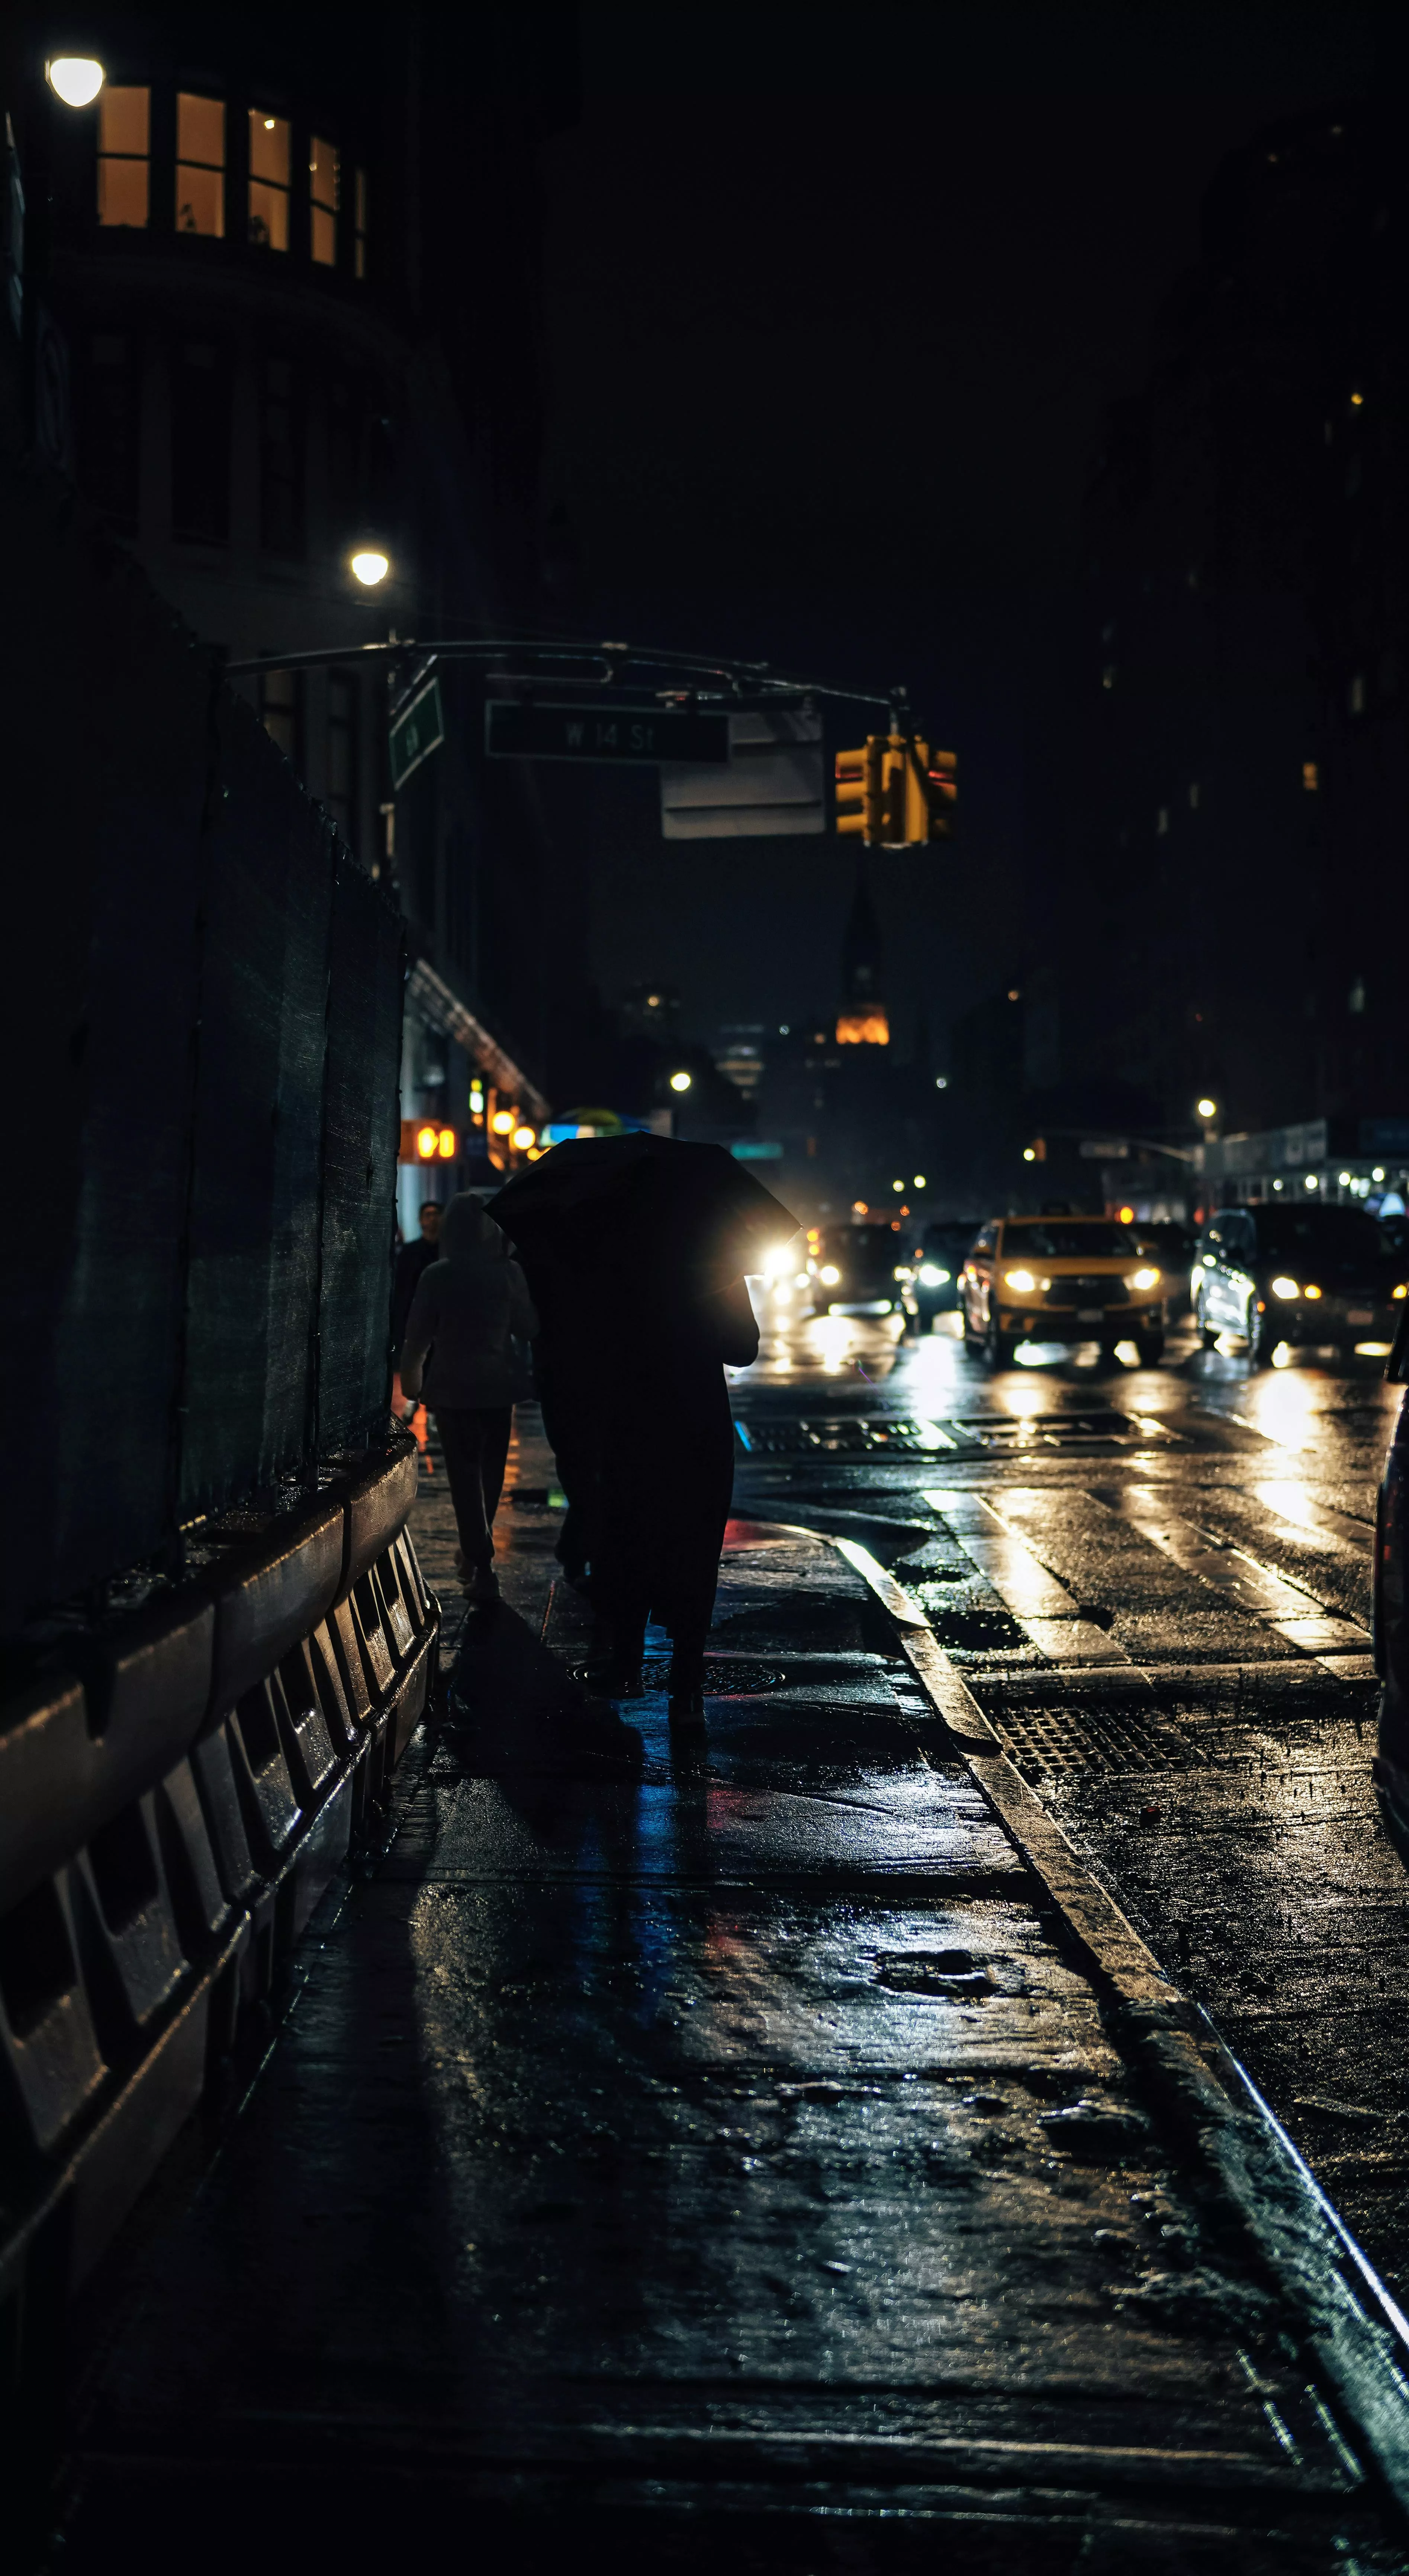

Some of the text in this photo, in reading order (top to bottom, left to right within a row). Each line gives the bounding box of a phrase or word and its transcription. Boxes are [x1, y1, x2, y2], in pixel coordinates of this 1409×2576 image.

[564, 722, 653, 750] W 14 St
